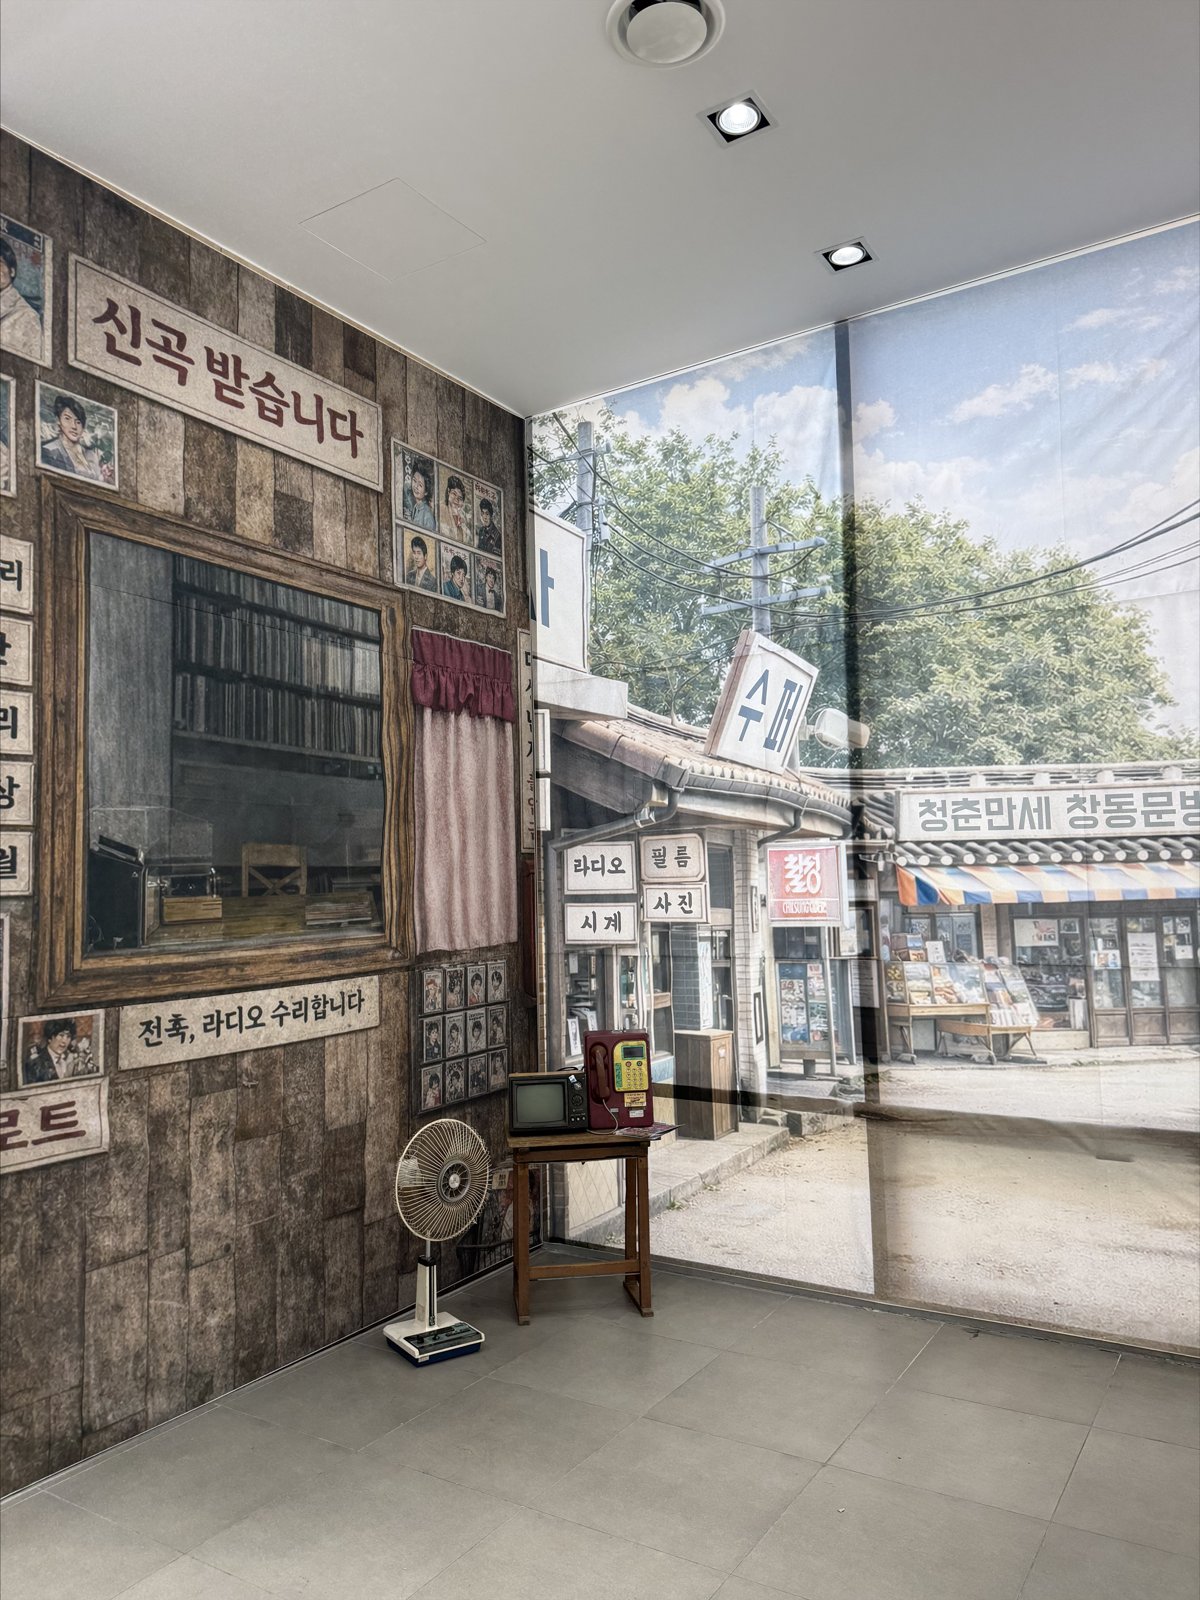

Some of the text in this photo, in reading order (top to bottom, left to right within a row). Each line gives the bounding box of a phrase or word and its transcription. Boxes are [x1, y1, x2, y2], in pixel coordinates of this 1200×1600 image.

[92, 297, 364, 459] 신곡 받습니다
[738, 668, 804, 753] 수퍼
[917, 795, 1052, 833] 청춘만세
[573, 854, 626, 878] 라디오
[651, 846, 692, 869] 필름
[652, 891, 694, 915] 사진
[580, 910, 622, 934] 시계
[202, 1005, 266, 1038] 라디오
[270, 988, 366, 1028] 수리합니다
